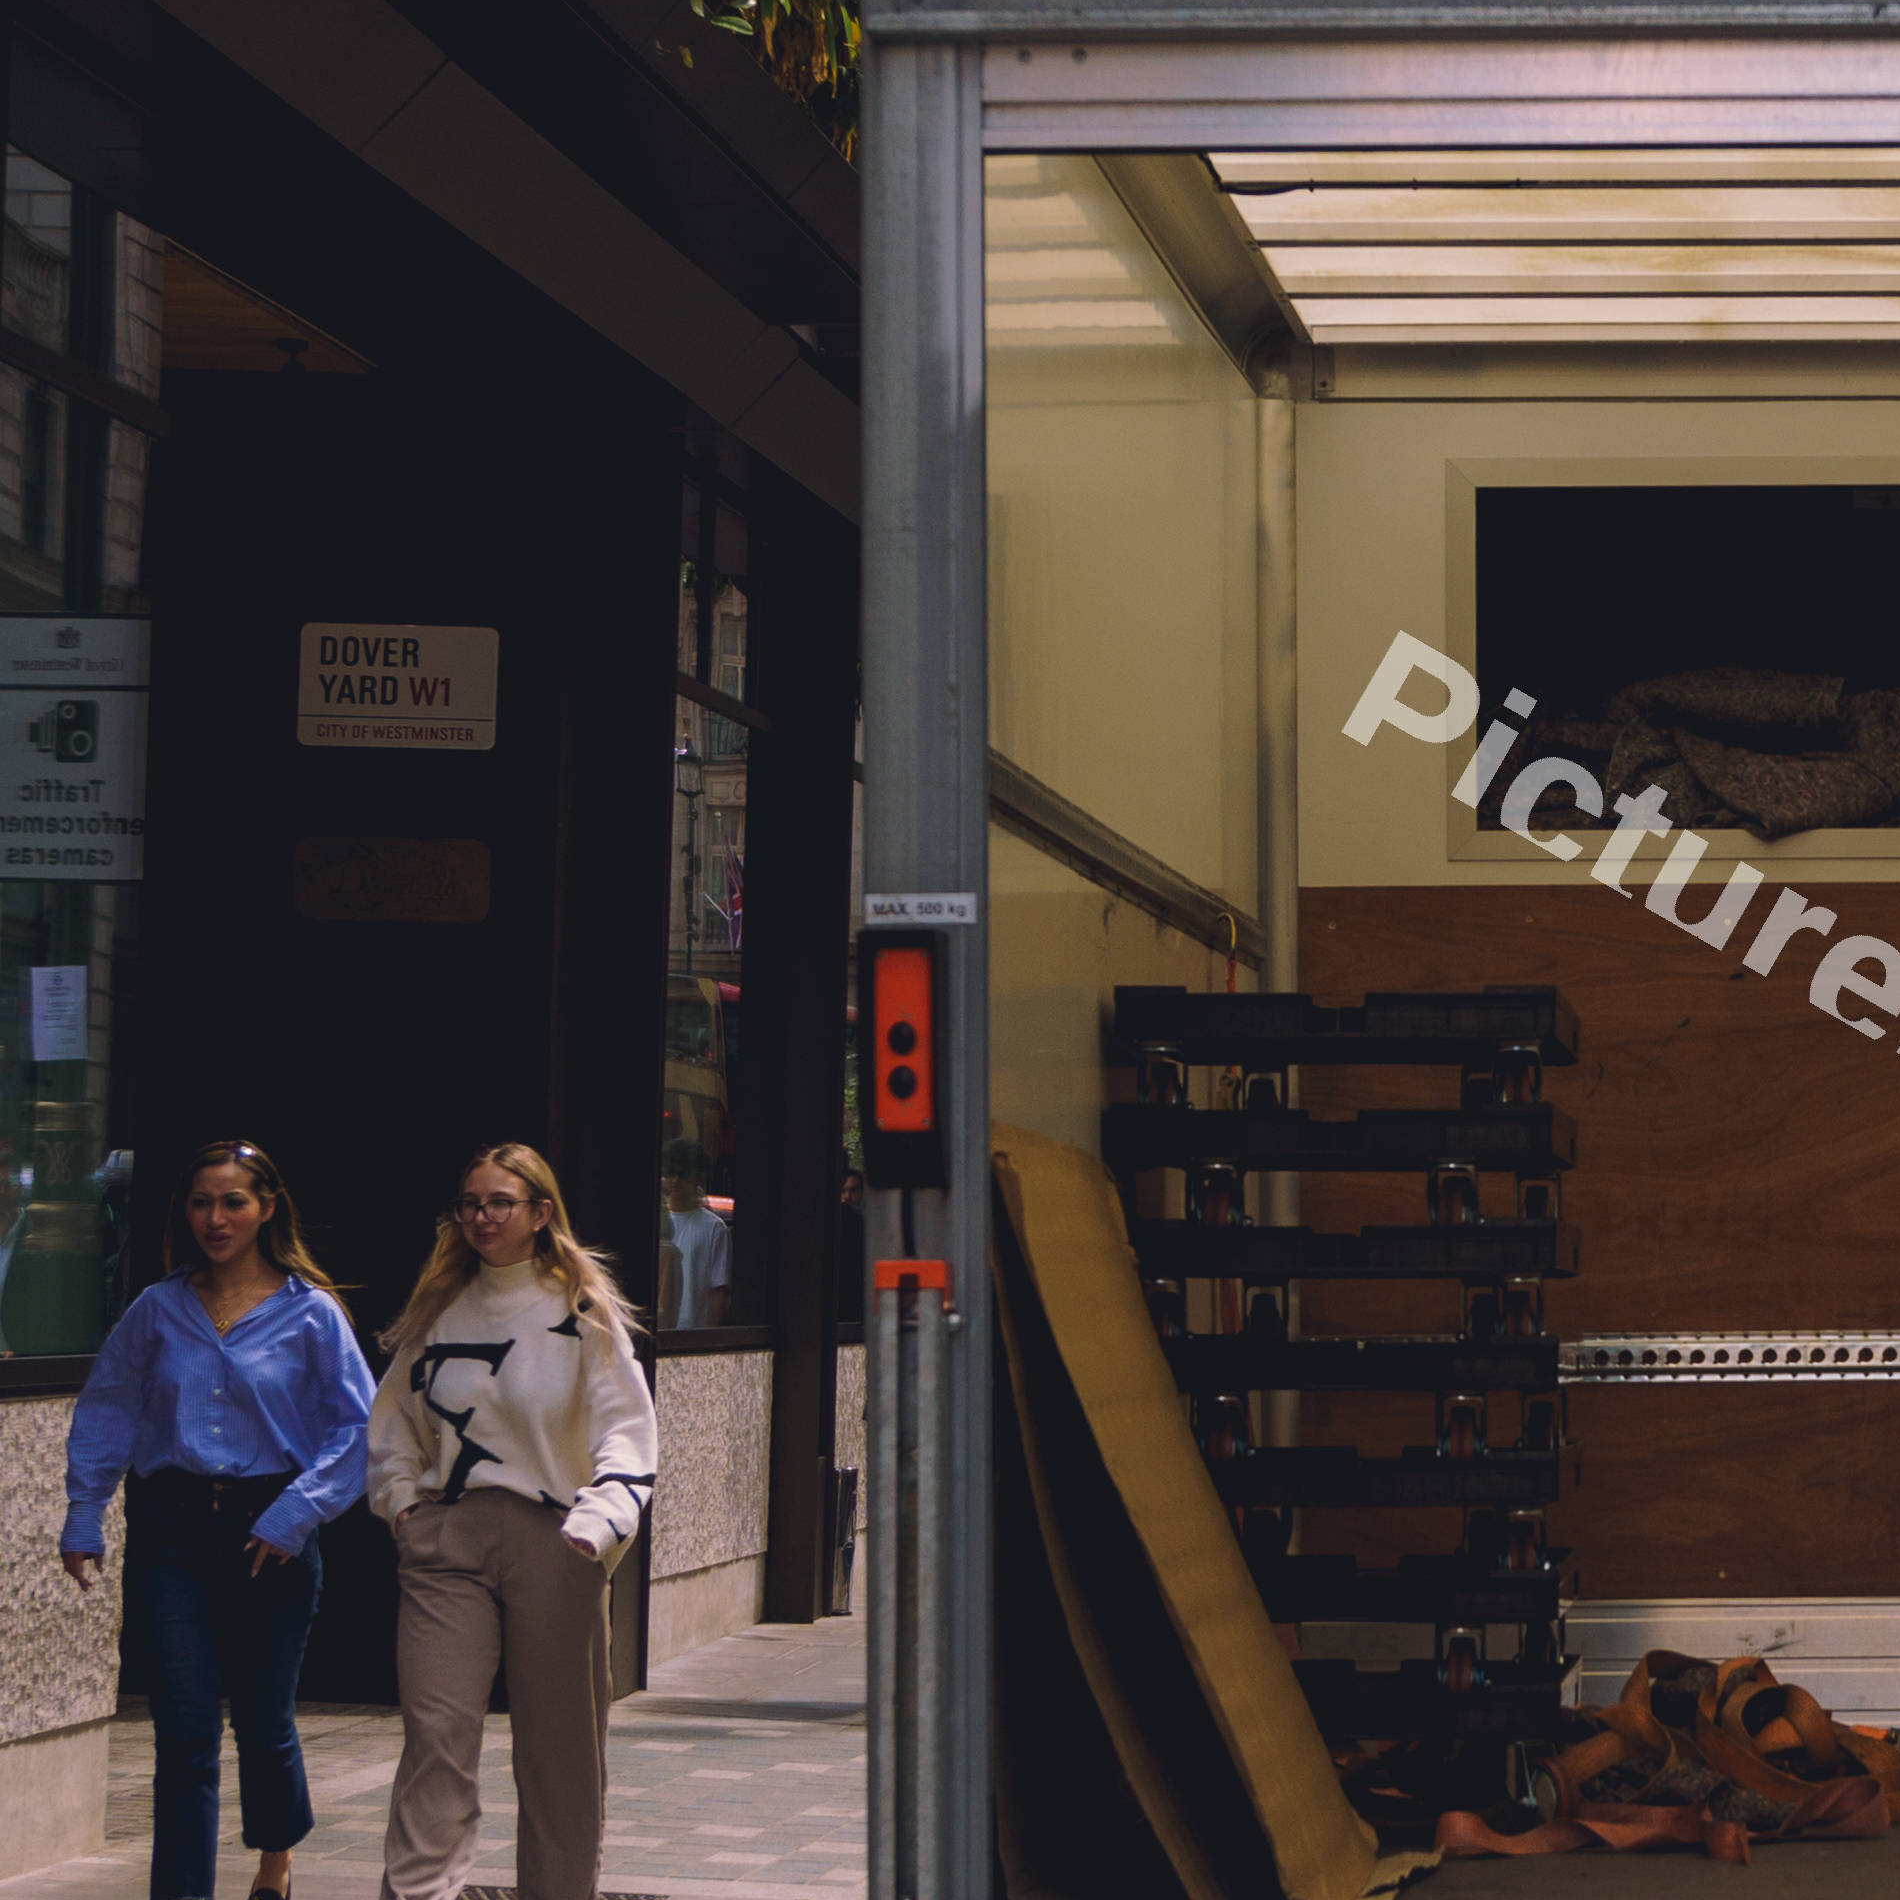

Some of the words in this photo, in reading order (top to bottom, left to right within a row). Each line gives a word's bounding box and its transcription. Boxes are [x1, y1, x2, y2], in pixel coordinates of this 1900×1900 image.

[319, 635, 420, 668] DOVER
[318, 673, 399, 706] YARD
[408, 676, 452, 707] W1
[316, 723, 348, 739] CITY
[351, 724, 370, 739] OF
[372, 725, 475, 742] WESTMINSTER
